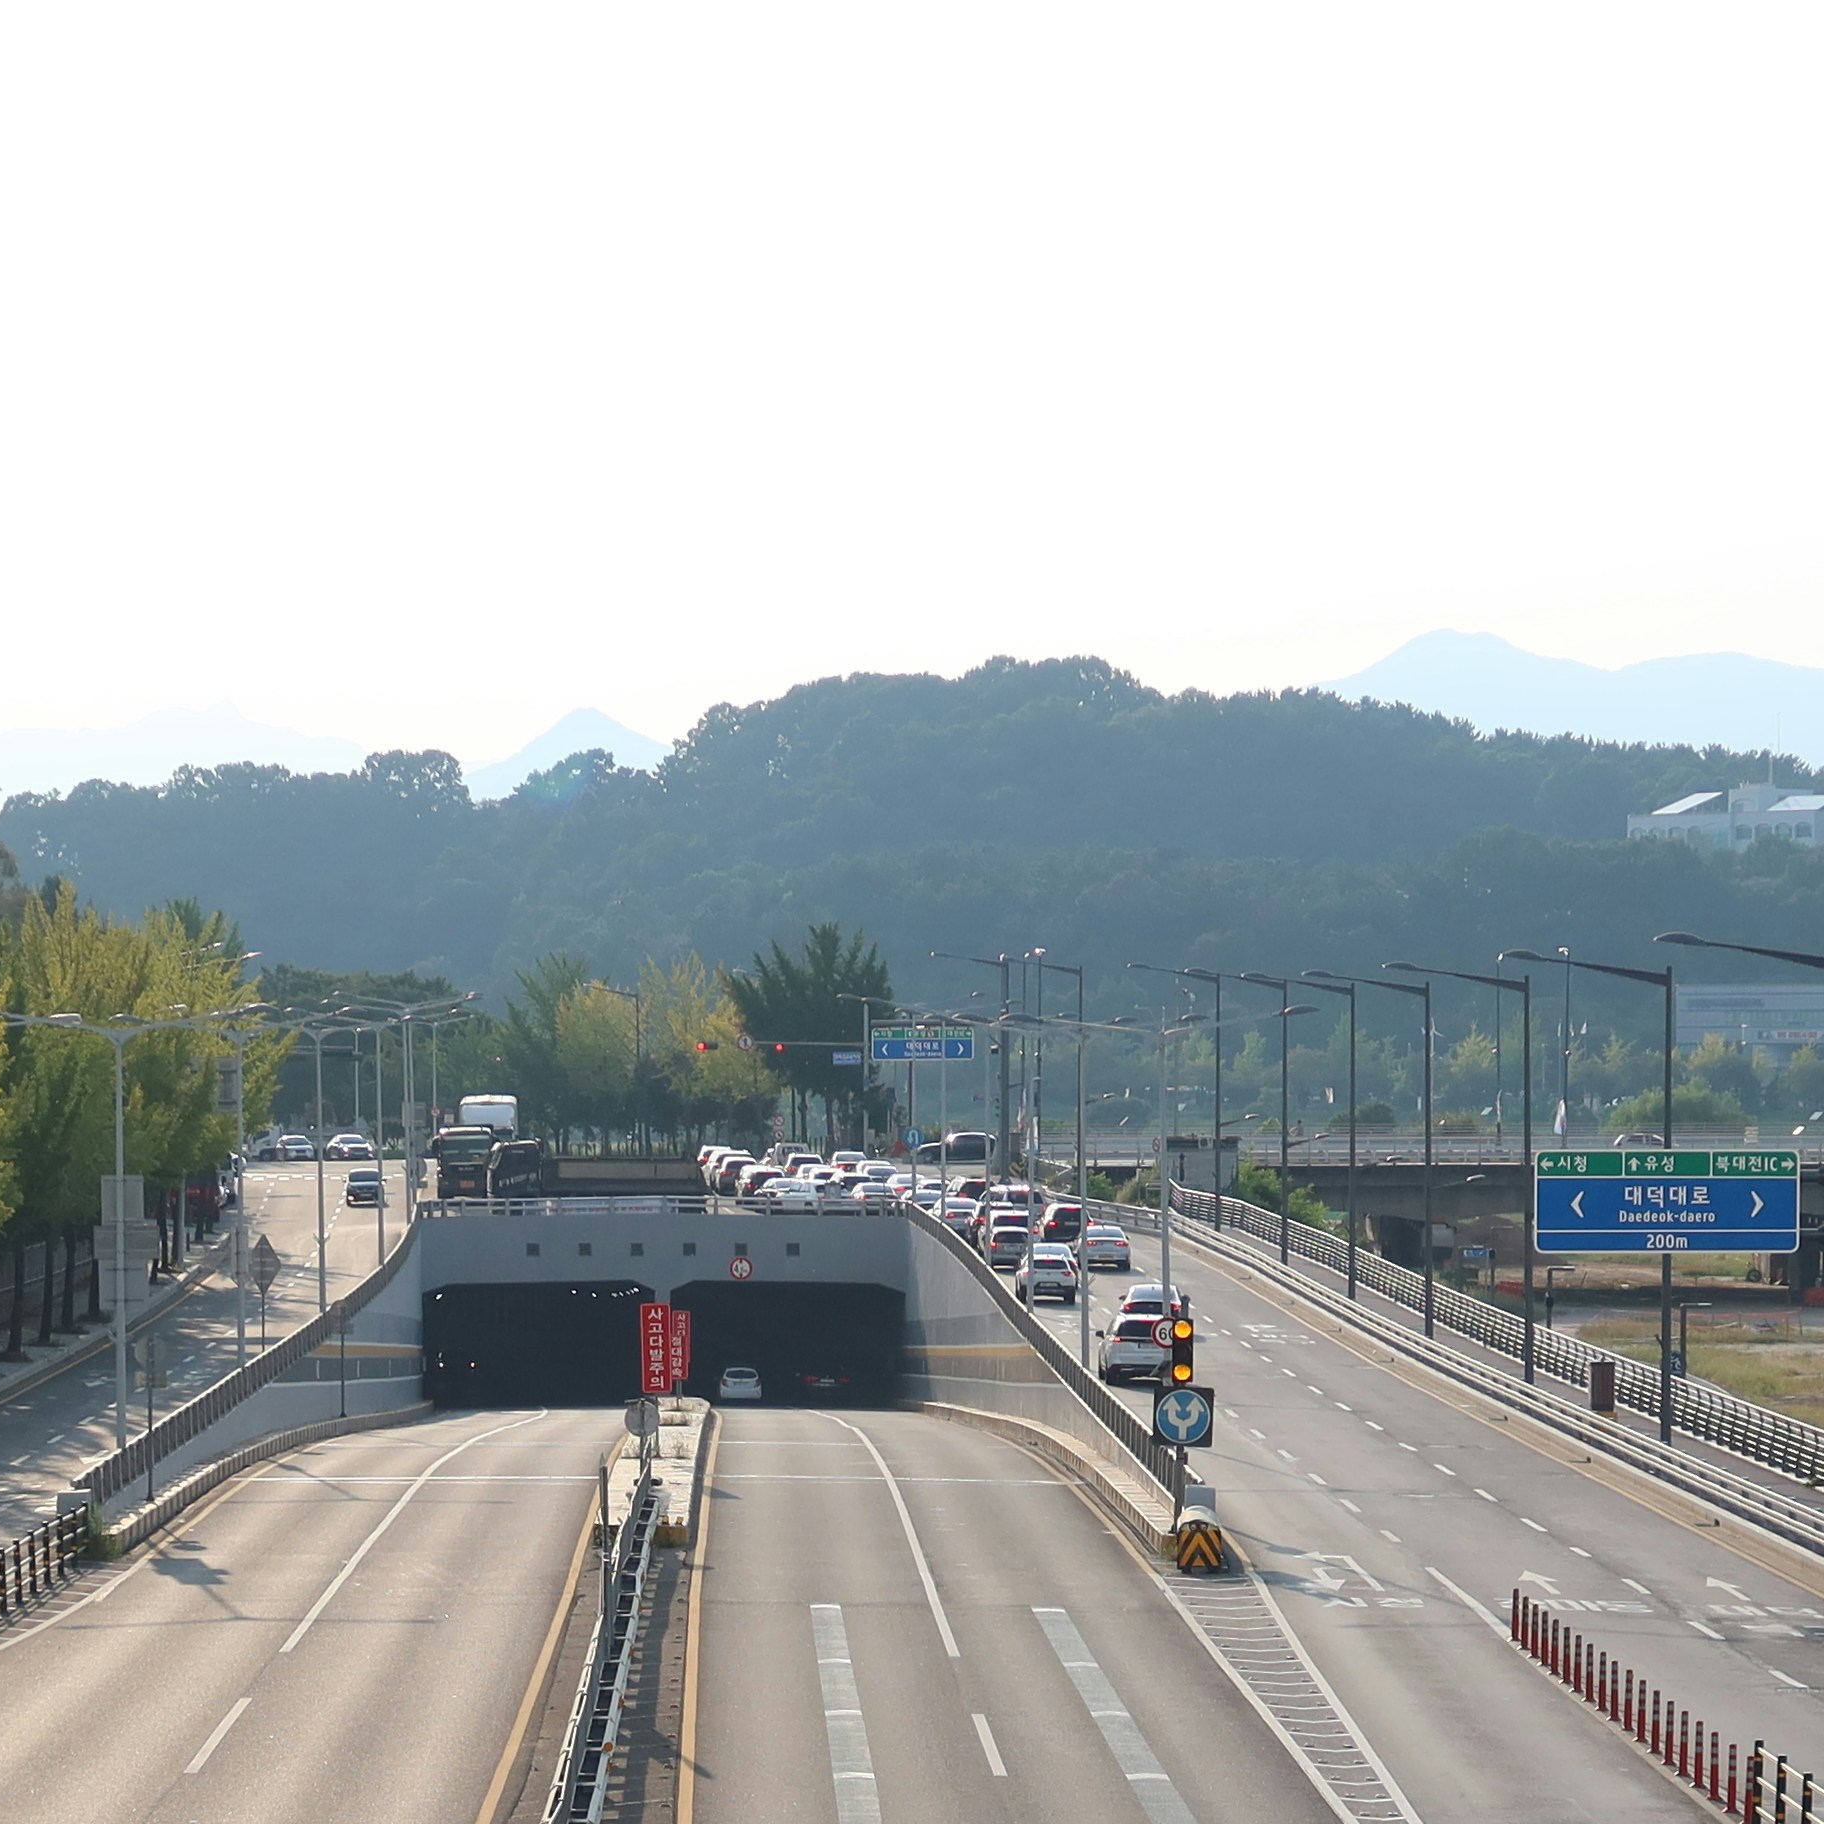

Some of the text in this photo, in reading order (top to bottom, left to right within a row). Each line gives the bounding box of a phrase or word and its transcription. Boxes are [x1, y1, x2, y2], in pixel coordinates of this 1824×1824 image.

[1557, 1155, 1589, 1172] 시청
[1643, 1155, 1676, 1172] 유성
[1715, 1155, 1779, 1173] 북대전IC
[1622, 1185, 1712, 1208] 대덕대로
[1618, 1209, 1717, 1224] Daedeok-daero
[1646, 1233, 1689, 1250] 200m
[647, 1307, 665, 1389] 사고다발주의
